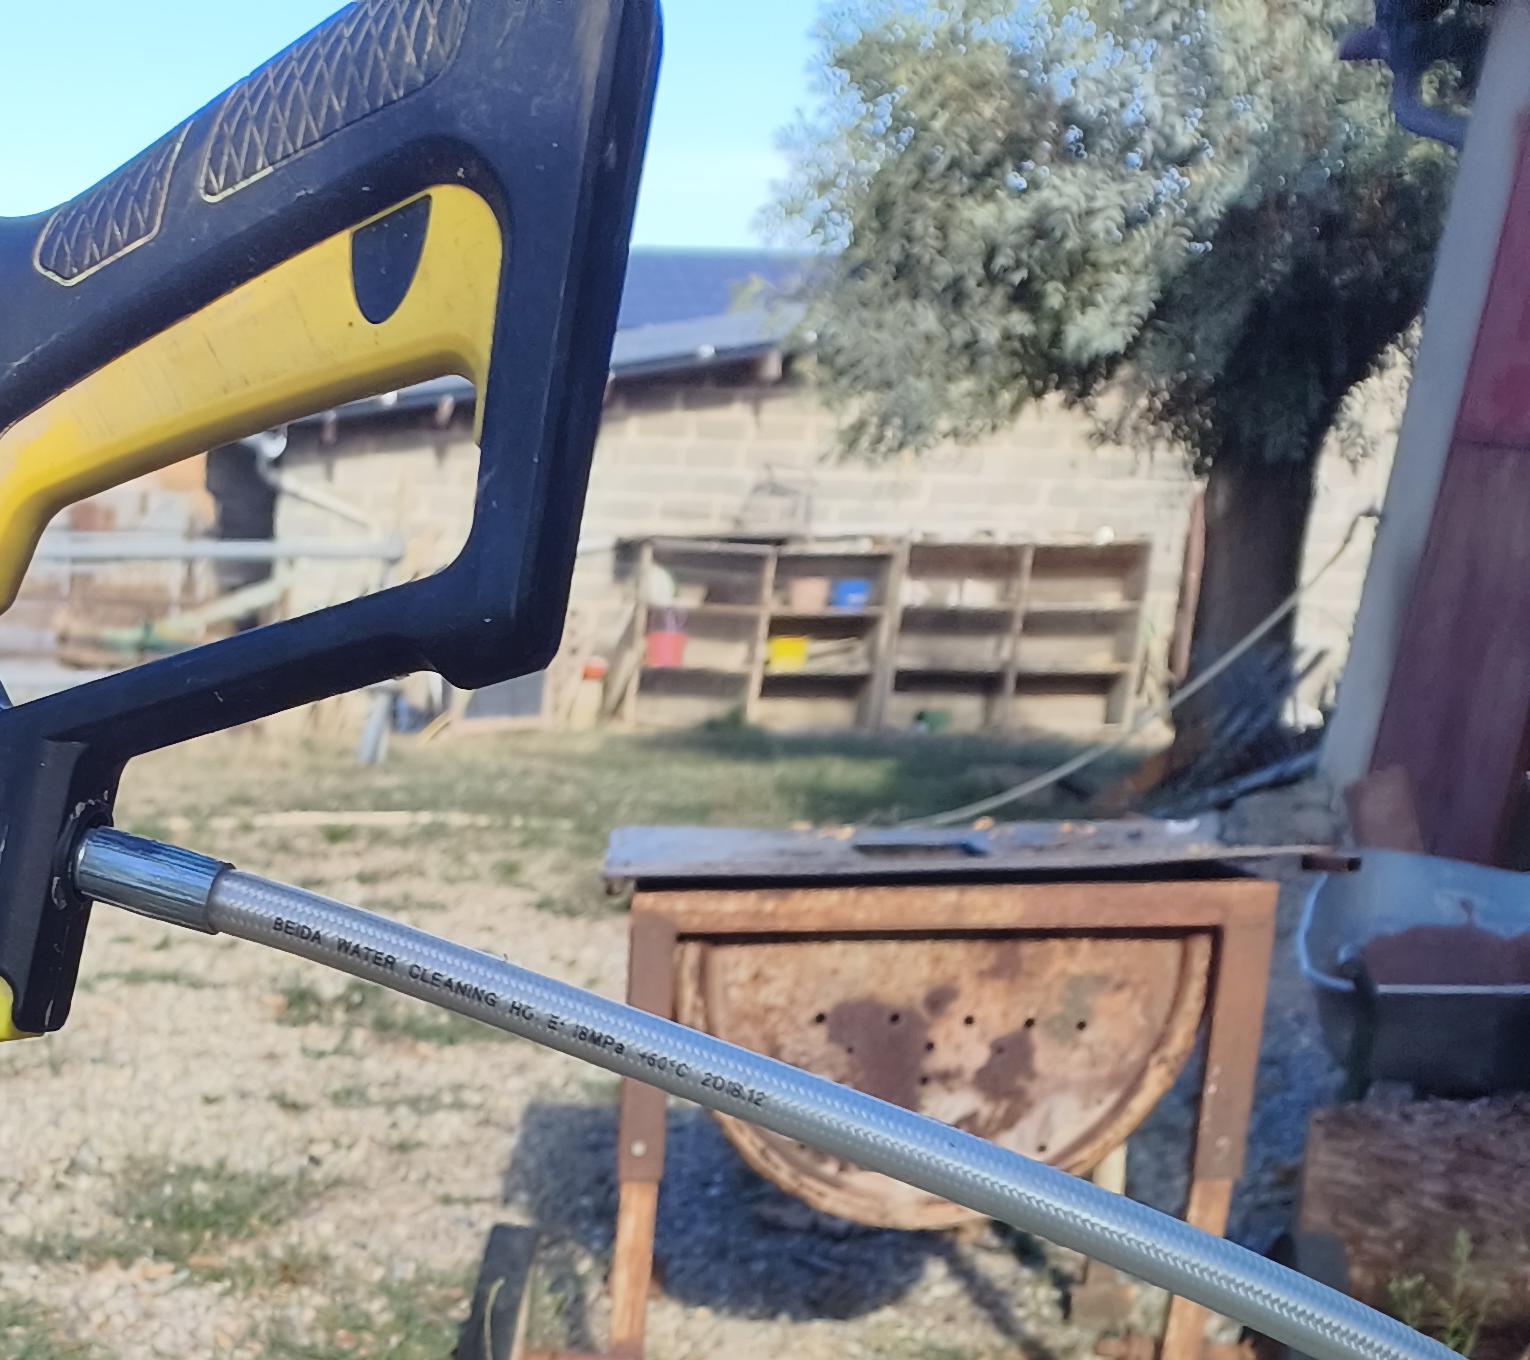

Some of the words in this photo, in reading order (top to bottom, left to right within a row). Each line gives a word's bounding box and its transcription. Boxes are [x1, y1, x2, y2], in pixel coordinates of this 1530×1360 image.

[271, 914, 325, 947] BEIDA
[334, 935, 397, 973] WATER
[405, 960, 499, 1010] CLEANING
